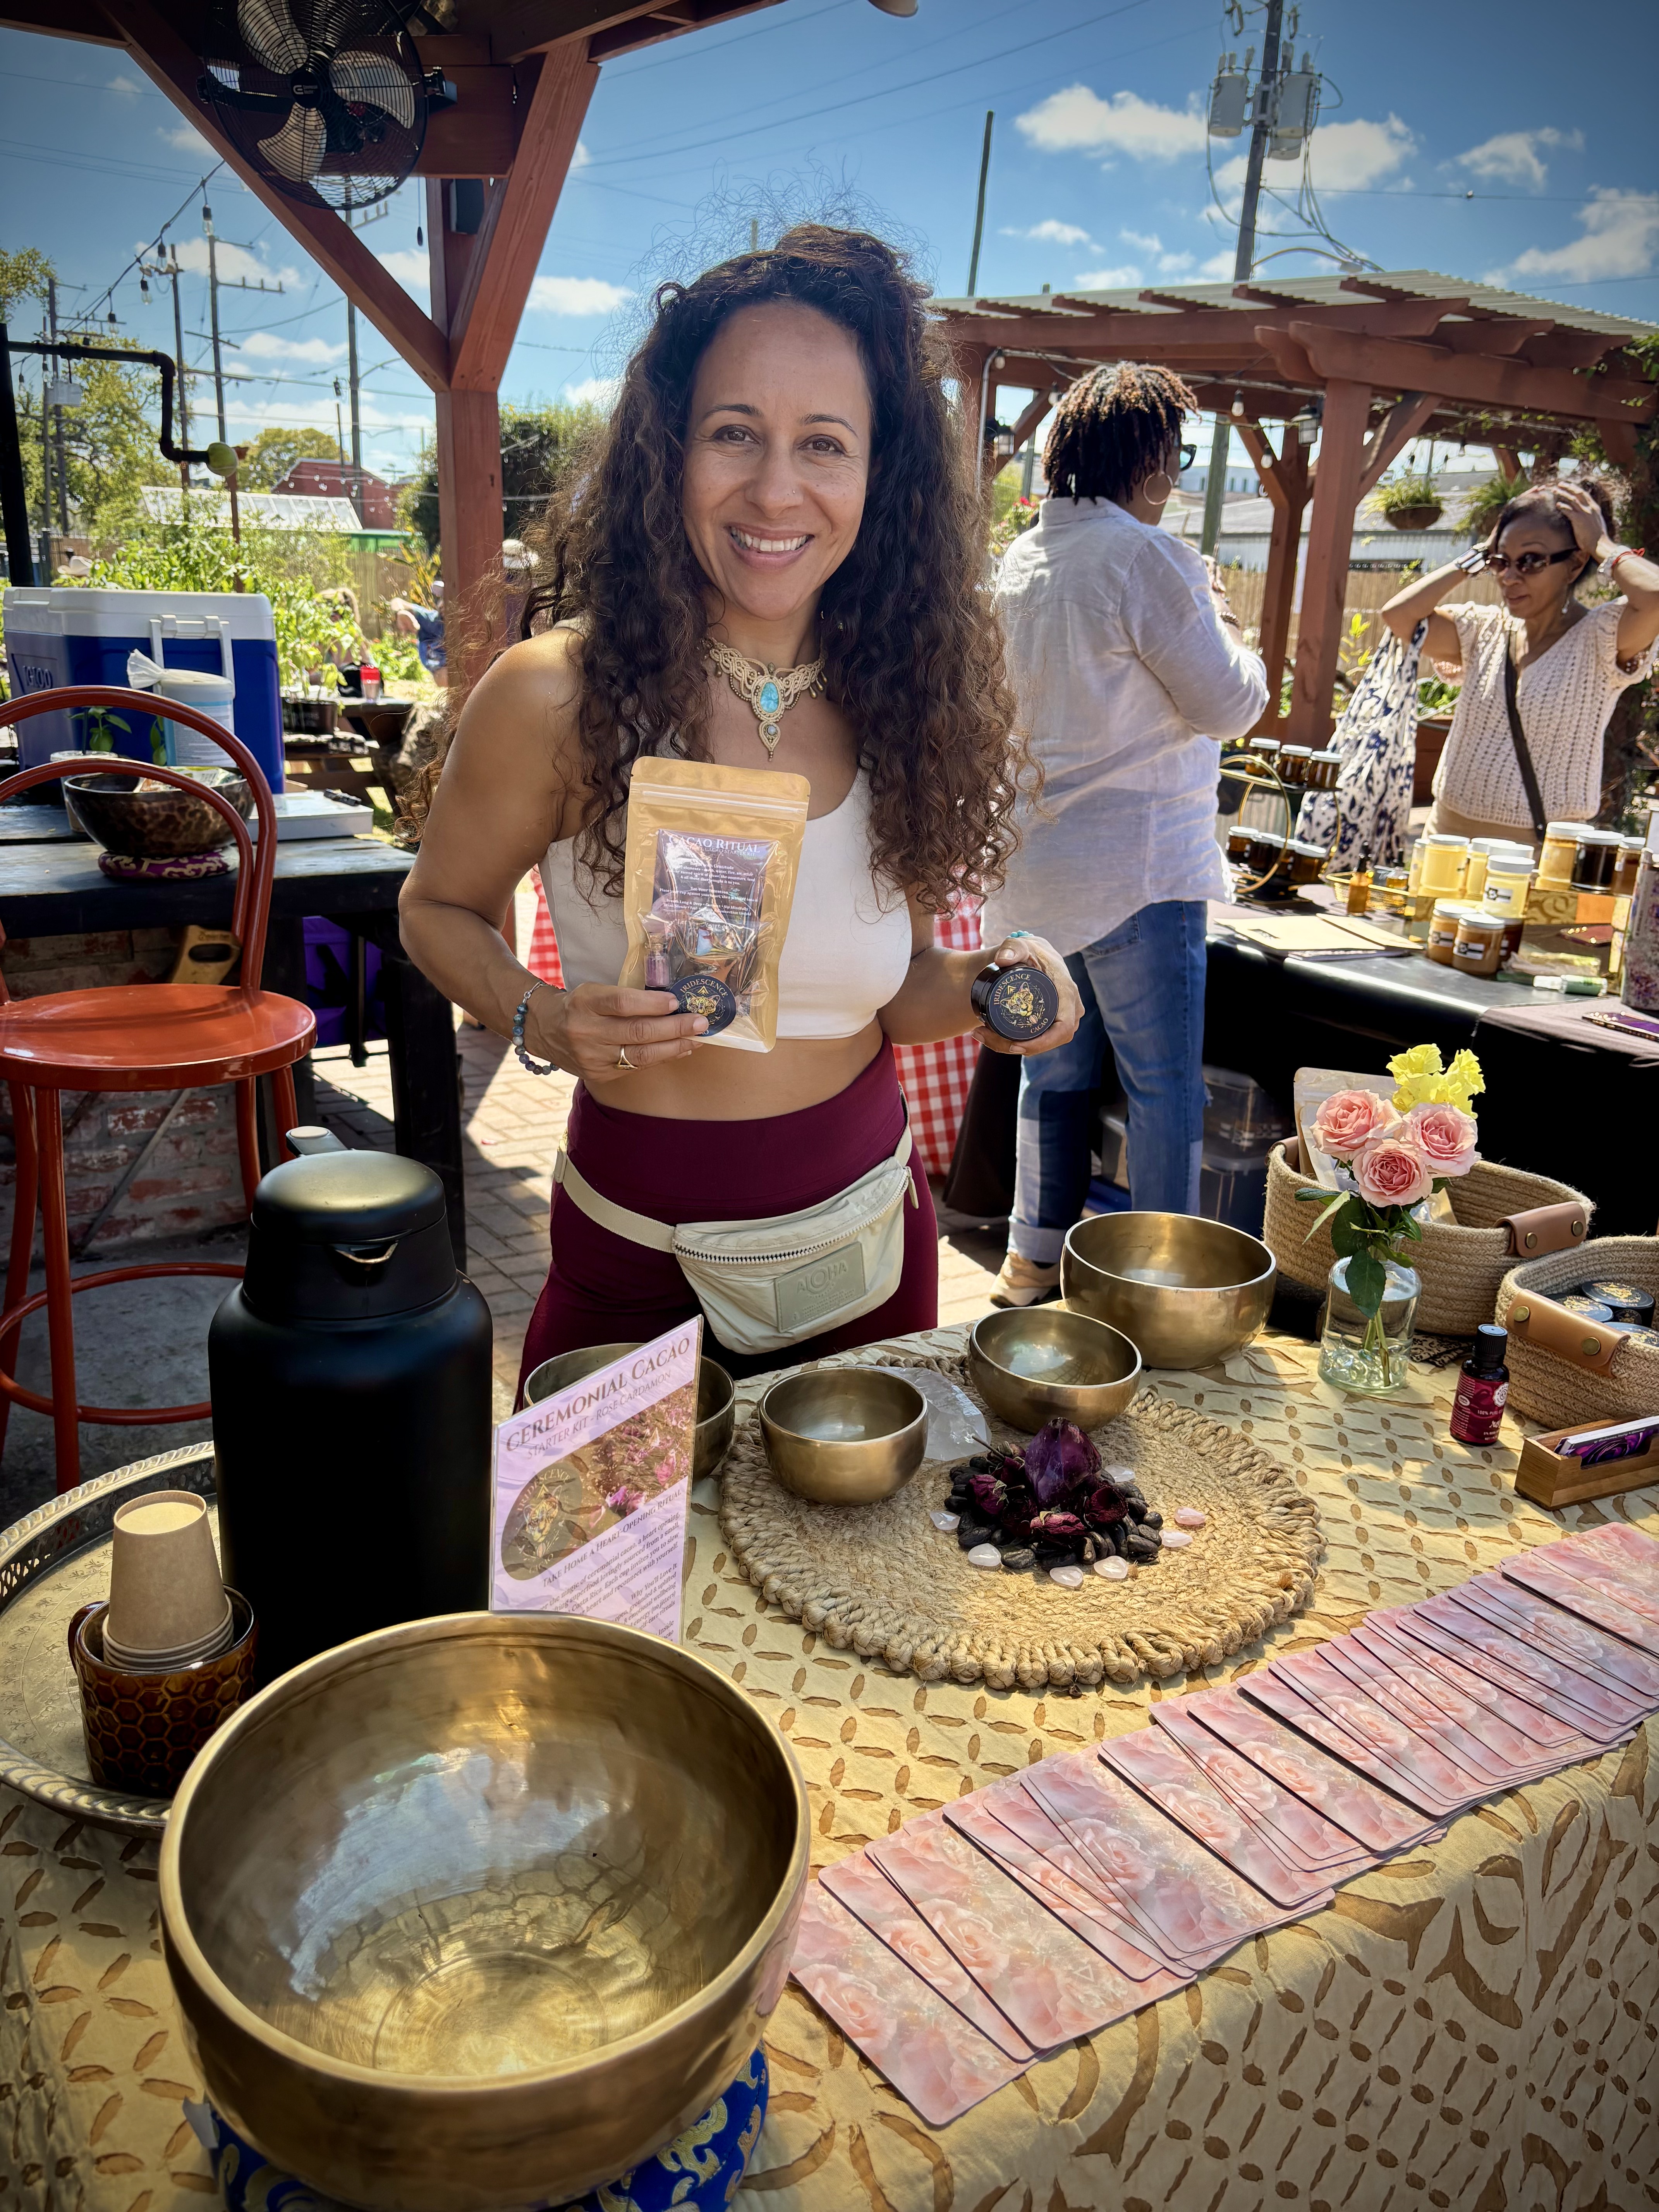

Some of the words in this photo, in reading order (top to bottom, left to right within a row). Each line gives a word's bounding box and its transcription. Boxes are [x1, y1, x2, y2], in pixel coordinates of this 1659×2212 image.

[716, 839, 760, 853] RITUAL
[680, 979, 728, 998] IRIDESCENCE
[994, 974, 1031, 1005] IRIDESCENCE
[1030, 1018, 1048, 1034] CACAO
[797, 1260, 847, 1294] ALOHA
[507, 1372, 627, 1451] CEREMONIAL
[632, 1338, 690, 1380] CACAO
[527, 1428, 569, 1459] STARTER
[573, 1416, 589, 1434] KIT
[596, 1400, 618, 1420] ROSE
[620, 1369, 671, 1405] CARDAMON
[517, 1468, 570, 1511] IRIDESCENCE
[543, 1570, 562, 1587] TAKE
[564, 1552, 588, 1574] HOME
[589, 1549, 594, 1557] A
[596, 1506, 656, 1551] HEART-OPENING
[658, 1489, 681, 1510] RITUAL
[550, 1597, 560, 1606] the
[562, 1582, 579, 1598] magic
[580, 1574, 587, 1585] of
[587, 1553, 619, 1579] ceremonial
[620, 1542, 637, 1556] cacao,
[642, 1527, 656, 1542] heart
[658, 1512, 680, 1531] opening,
[570, 1577, 599, 1602] superfood
[600, 1562, 623, 1581] lovingly
[623, 1545, 645, 1565] sourced
[646, 1537, 659, 1549] from
[665, 1522, 679, 1536] small,
[572, 1598, 588, 1612] Costa
[589, 1588, 603, 1600] Rica.
[605, 1575, 618, 1589] Each
[620, 1569, 629, 1578] cup
[630, 1554, 649, 1571] invites
[650, 1547, 659, 1558] you
[667, 1532, 679, 1544] slow
[586, 1597, 601, 1612] heart
[603, 1588, 613, 1601] and
[615, 1569, 642, 1592] reconnect
[643, 1559, 655, 1571] with
[656, 1541, 678, 1563] yourself.
[628, 1598, 653, 1620] emotional
[654, 1581, 676, 1601] wellbeing
[629, 1589, 653, 1613] grounded
[658, 1571, 676, 1589] uplifted
[631, 1588, 643, 1600] Why
[644, 1577, 658, 1590] You'll
[660, 1568, 672, 1580] Love
[634, 1610, 651, 1626] energy
[659, 1591, 676, 1608] jitters)
[640, 1613, 658, 1630] elf-care
[660, 1600, 675, 1615] rituals
[659, 1620, 674, 1635] Inside
